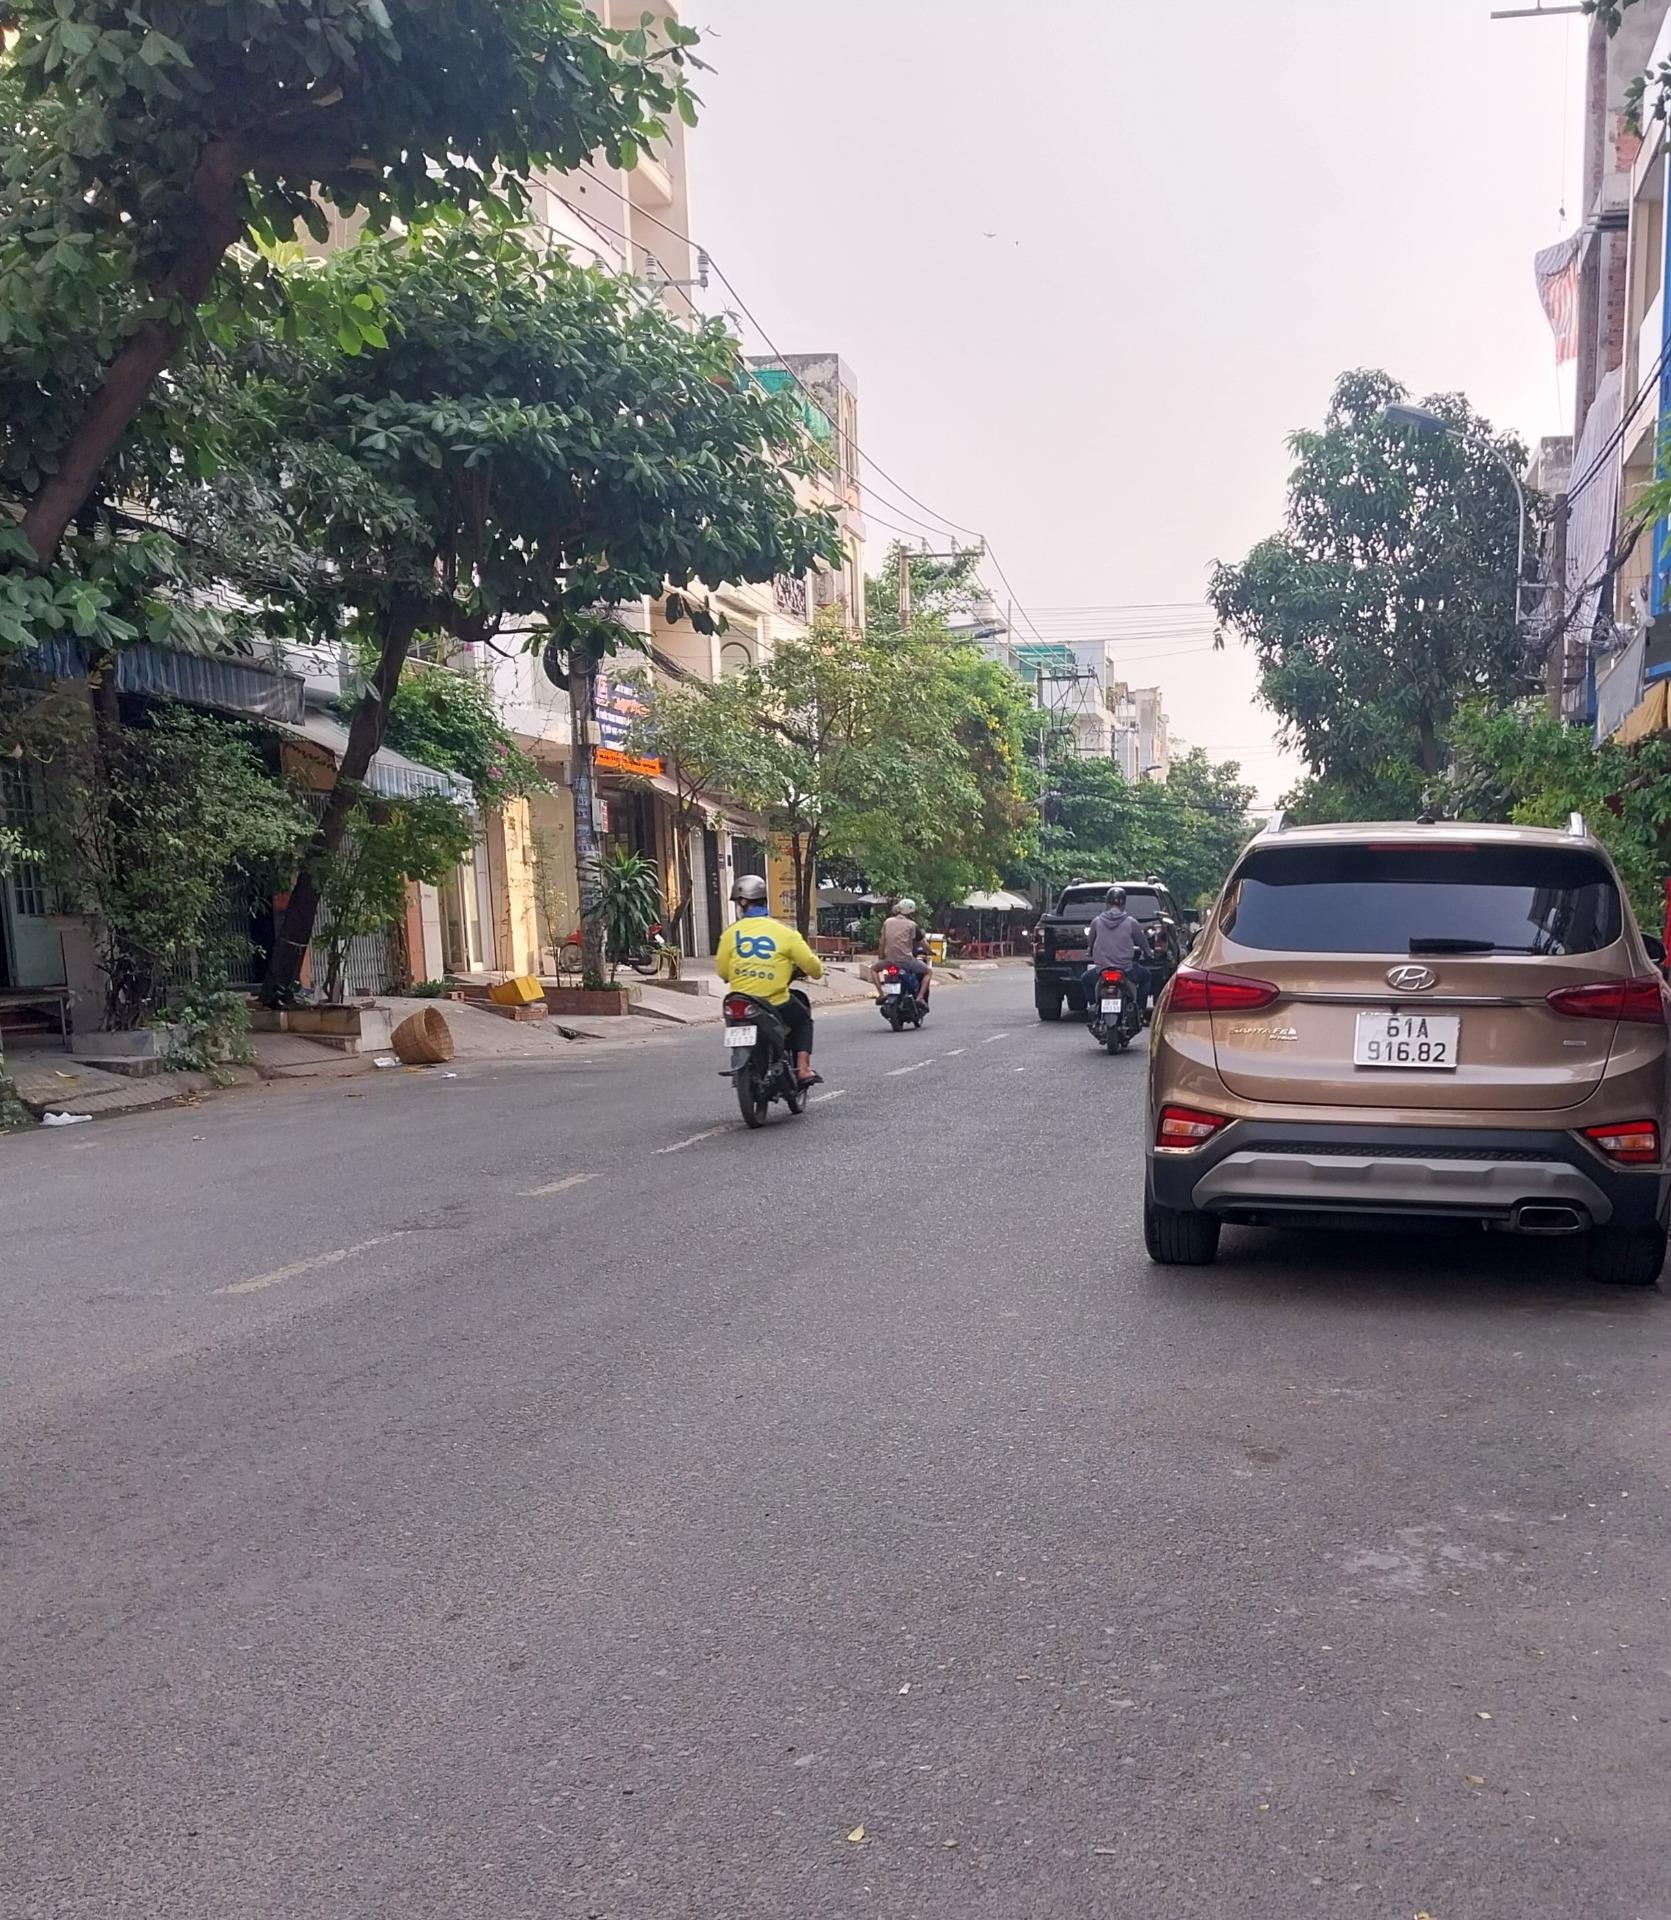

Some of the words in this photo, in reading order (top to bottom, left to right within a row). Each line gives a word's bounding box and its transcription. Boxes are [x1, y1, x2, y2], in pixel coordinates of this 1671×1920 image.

[736, 930, 776, 959] be
[1387, 1018, 1428, 1038] 61A
[1368, 1041, 1446, 1062] 916.82
